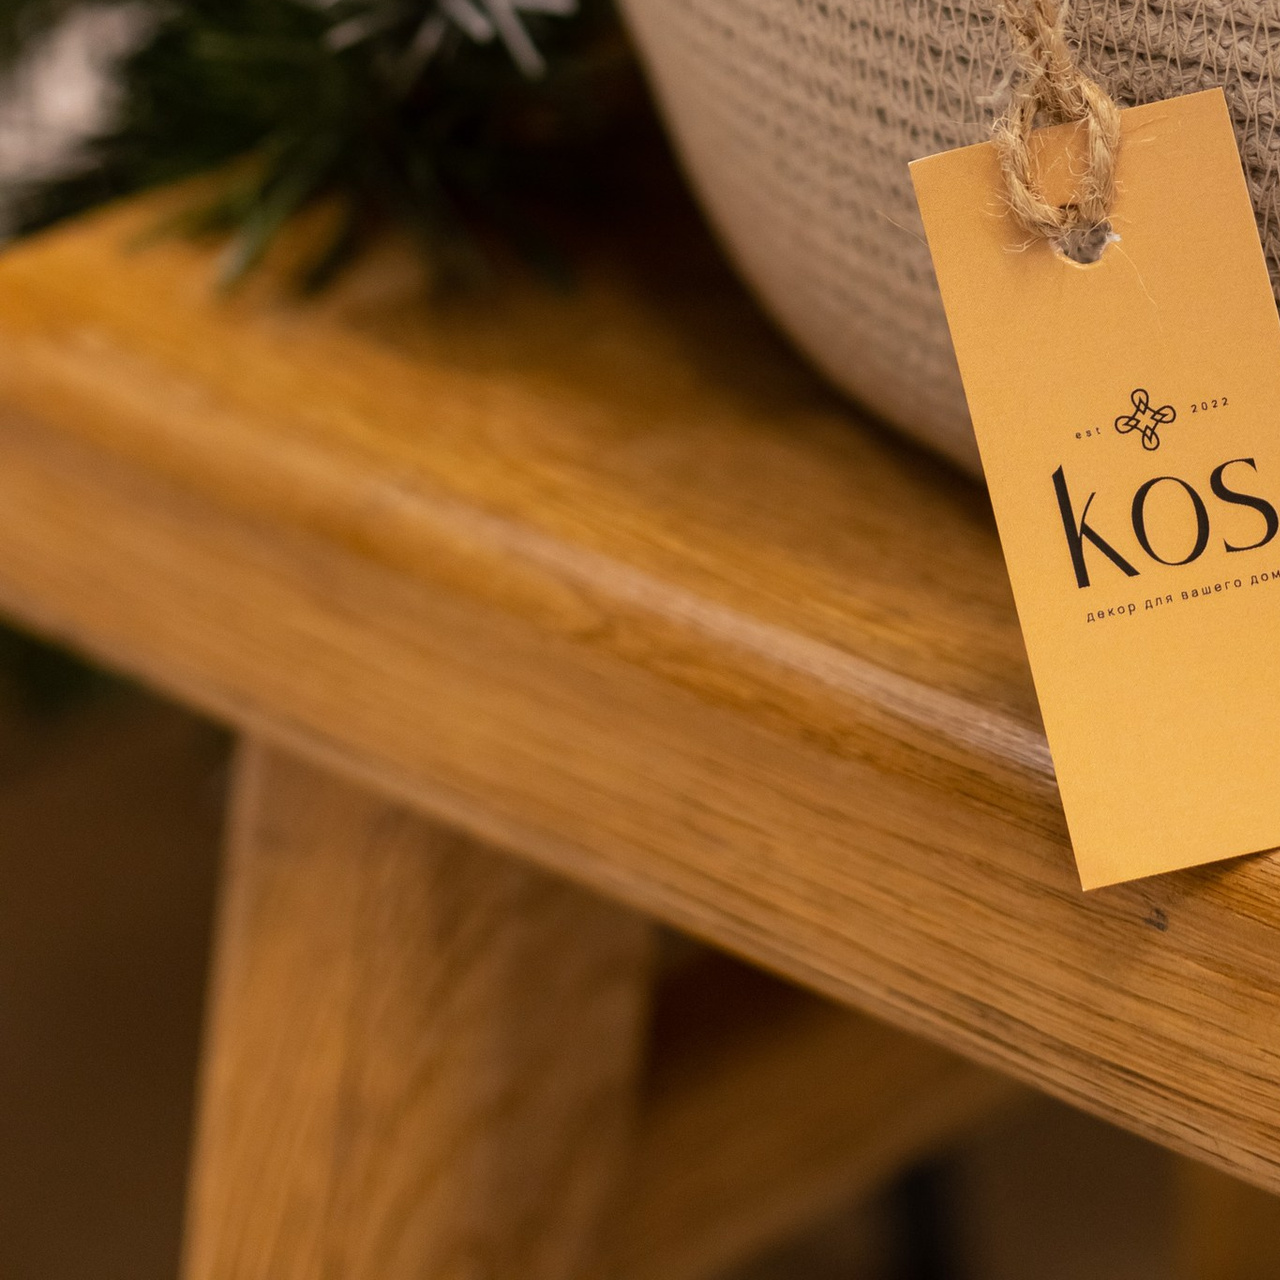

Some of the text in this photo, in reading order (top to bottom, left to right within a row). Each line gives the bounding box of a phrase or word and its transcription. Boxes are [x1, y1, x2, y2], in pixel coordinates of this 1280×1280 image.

[1075, 396, 1229, 439] est 2022
[1086, 602, 1137, 623] декор
[1144, 593, 1174, 610] для
[1181, 577, 1243, 600] вашего
